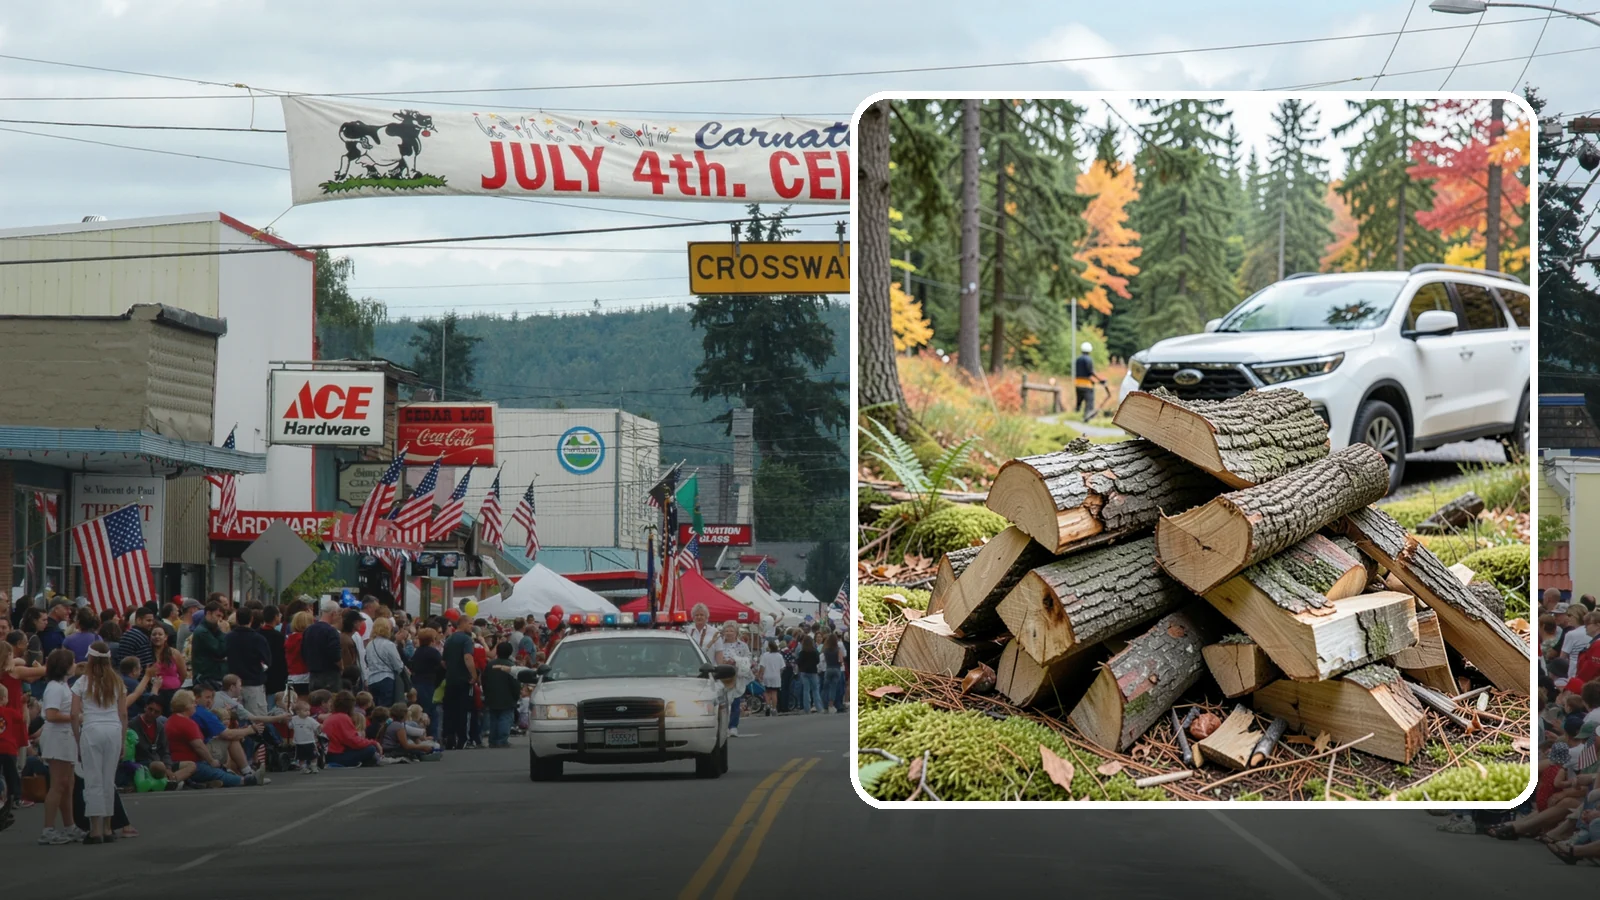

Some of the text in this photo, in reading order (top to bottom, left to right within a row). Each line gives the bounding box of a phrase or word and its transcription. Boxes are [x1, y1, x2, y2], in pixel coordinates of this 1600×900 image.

[695, 121, 850, 150] Carnat
[481, 140, 605, 192] JULY
[632, 150, 746, 198] 4th.
[697, 254, 850, 280] CROSSWA
[282, 380, 373, 420] ACE
[406, 409, 452, 421] CEDAR
[283, 421, 371, 436] Hardware
[416, 428, 477, 447] Coca-Cola
[83, 485, 155, 495] St. Vincent de Paul
[81, 503, 154, 522] THT
[688, 526, 742, 535] CRNATION
[699, 535, 730, 543] GLASS
